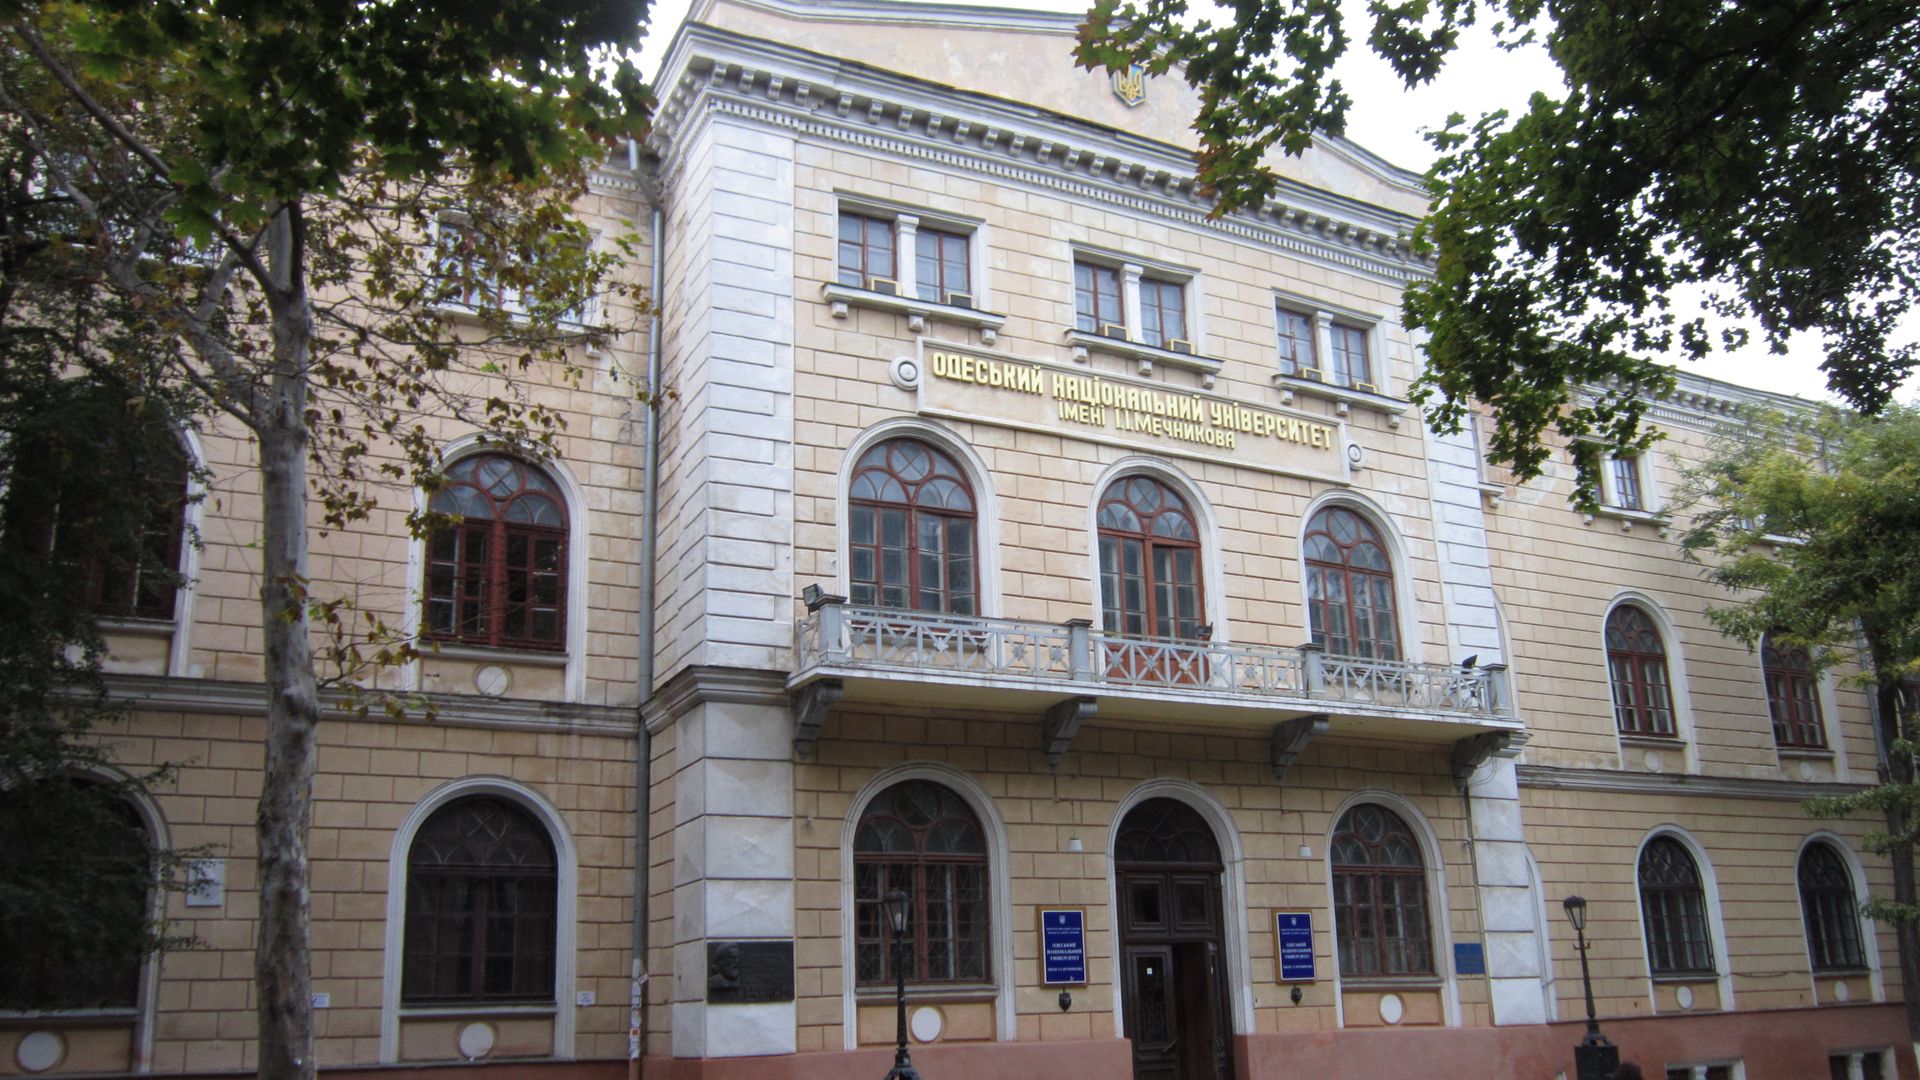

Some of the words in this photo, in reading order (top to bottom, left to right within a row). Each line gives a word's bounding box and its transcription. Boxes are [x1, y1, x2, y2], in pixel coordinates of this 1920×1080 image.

[933, 352, 1044, 395] ОДЕСЬКИЙ
[1052, 373, 1204, 424] НАЦІОНАЛЬНИЙ
[1210, 402, 1332, 450] УНІВЕРСИТЕТ
[1058, 398, 1106, 427] ІМЕНІ
